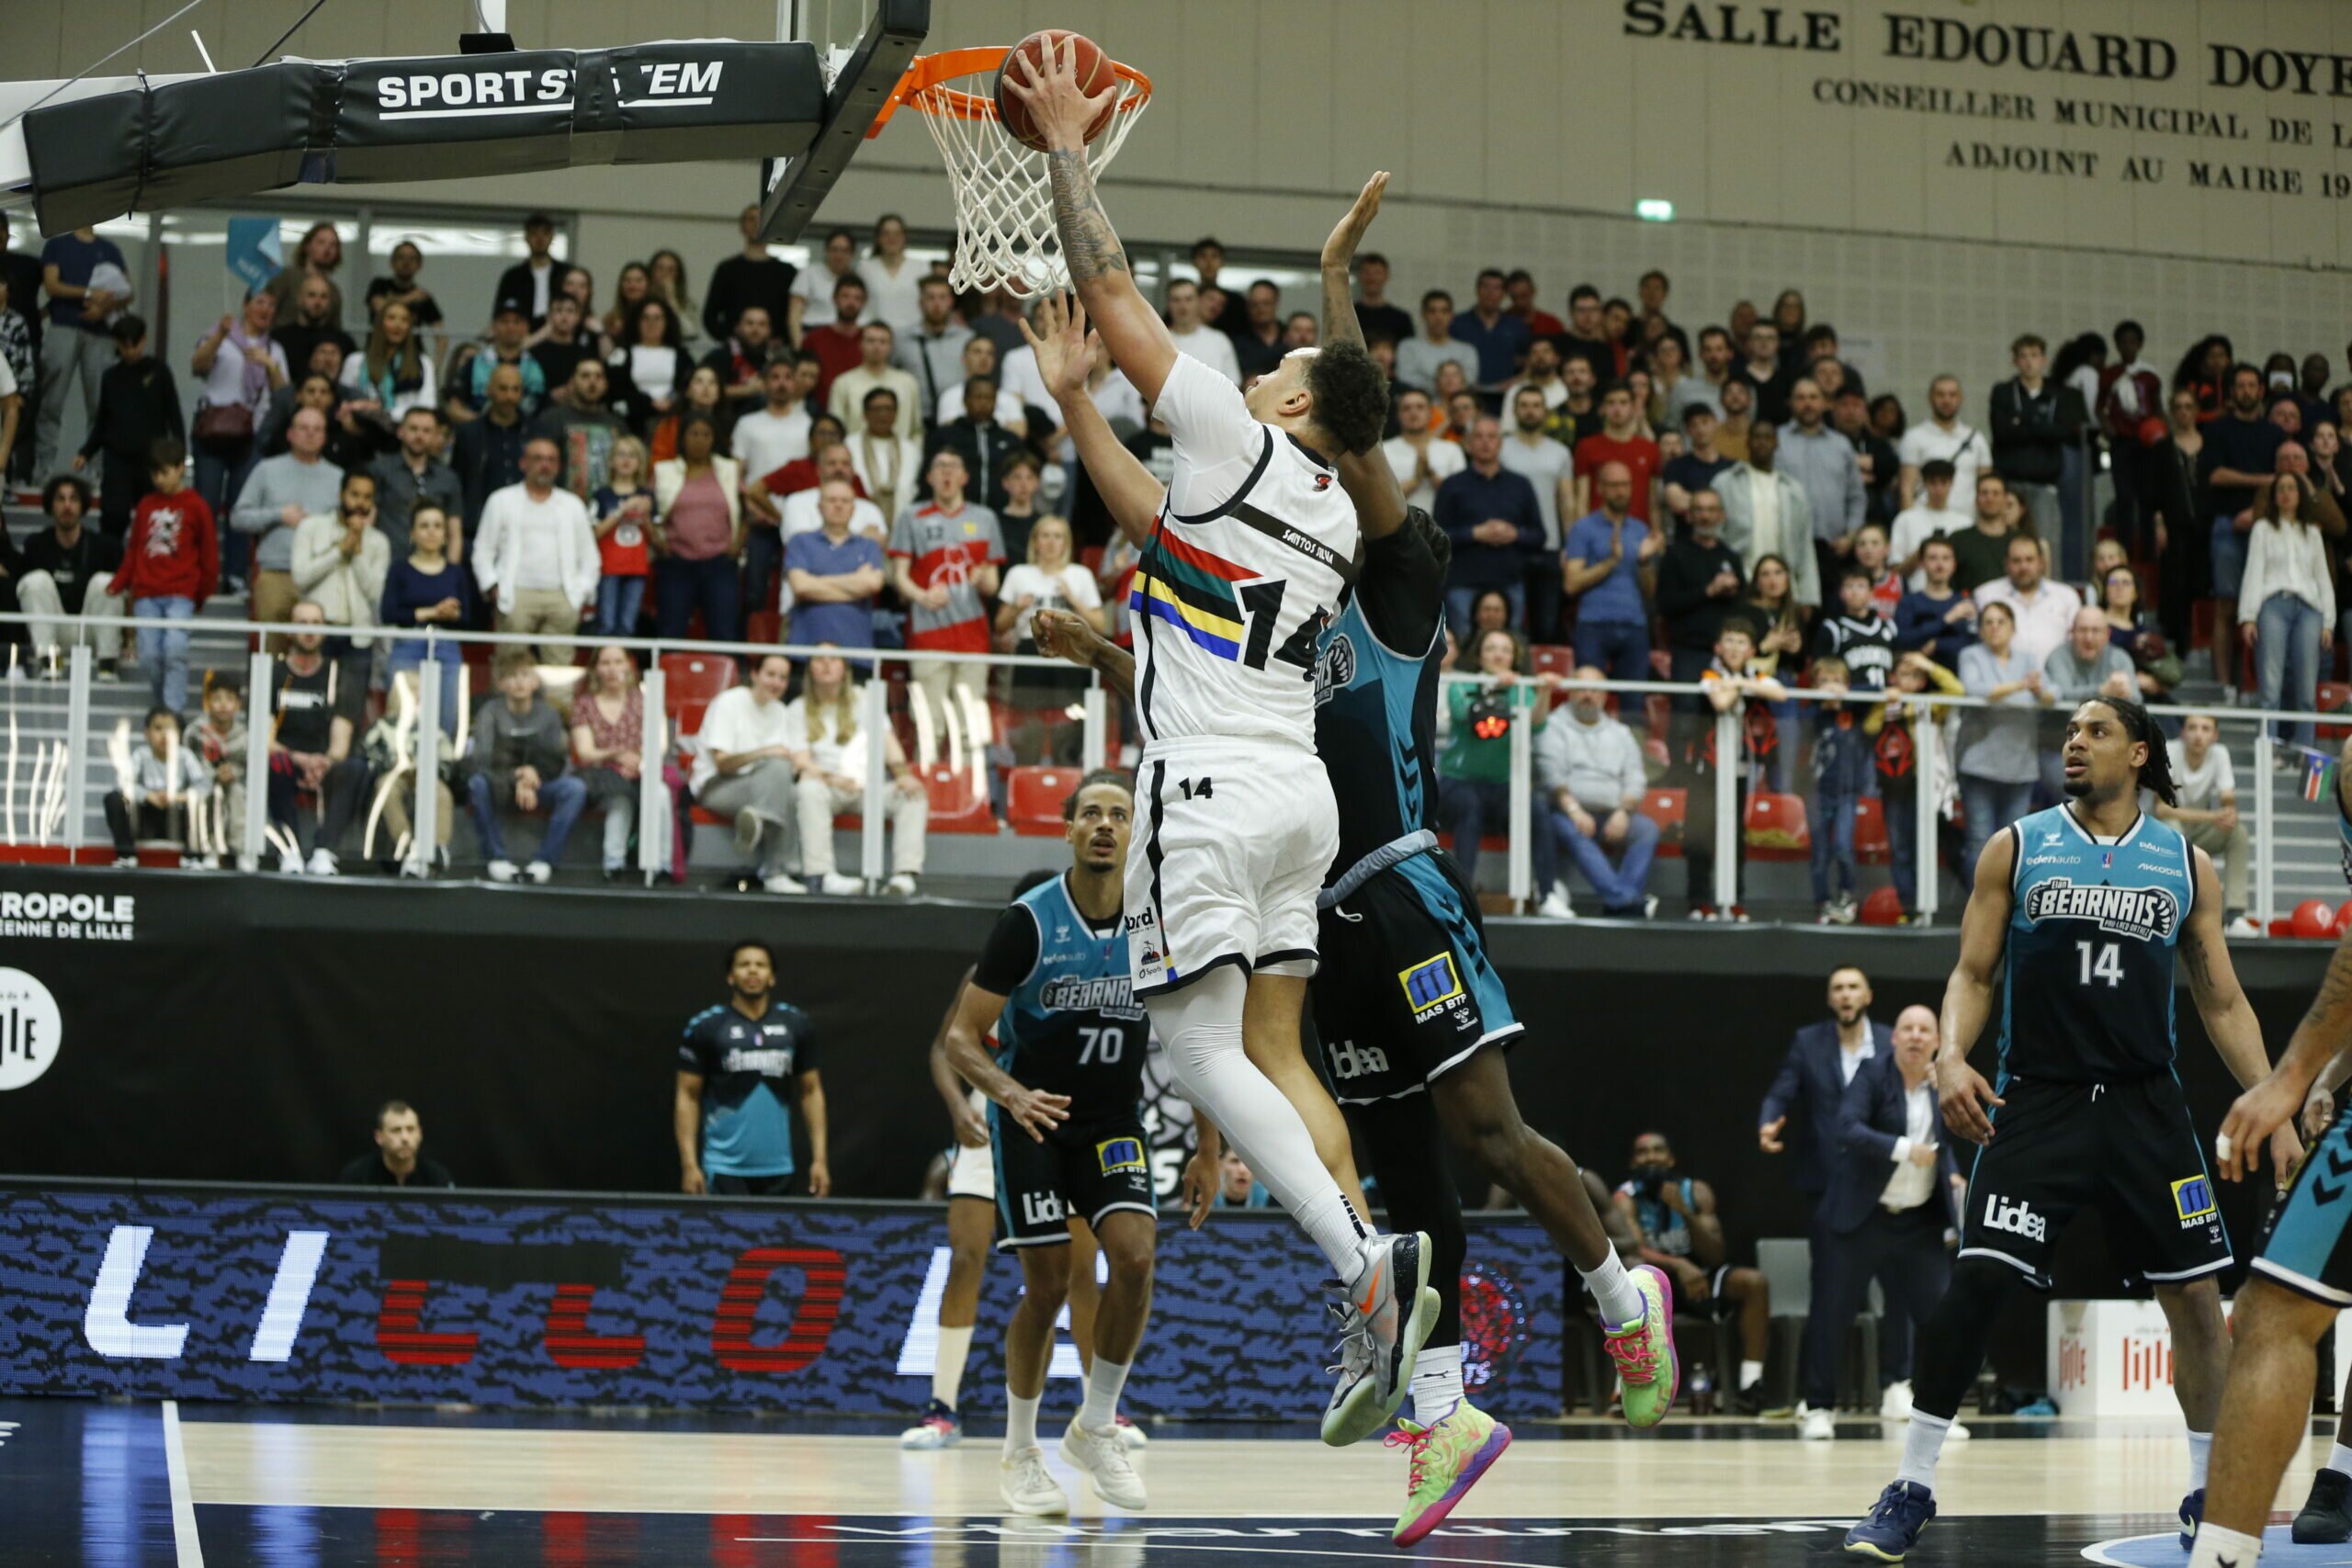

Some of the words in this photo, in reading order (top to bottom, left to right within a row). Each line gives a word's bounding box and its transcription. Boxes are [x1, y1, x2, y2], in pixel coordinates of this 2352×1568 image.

[1623, 0, 1841, 52] SALLE
[1882, 13, 2177, 82] EDOUARD
[378, 70, 532, 108] SPORT
[1812, 76, 2036, 123] CONSEILLER
[2054, 97, 2249, 141] MUNICIPAL
[2268, 117, 2312, 146] DE
[2331, 121, 2352, 149] L
[1945, 141, 2098, 177] ADJOINT
[2120, 157, 2165, 184] AU
[2188, 160, 2302, 196] MAIRE
[1282, 529, 1317, 554] SANTOS
[1178, 776, 1214, 801] 14
[2025, 853, 2081, 866] edenauto
[0, 891, 136, 923] ROPOLE
[2039, 887, 2159, 928] BEARNAIS
[57, 921, 82, 939] DE
[85, 922, 134, 942] LILLE
[2075, 940, 2125, 987] 14
[1415, 1002, 1444, 1025] MAS
[1446, 992, 1468, 1011] BTP
[1078, 1027, 1125, 1066] 70
[1983, 1193, 2046, 1243] Lidea
[2180, 1215, 2205, 1230] MAS
